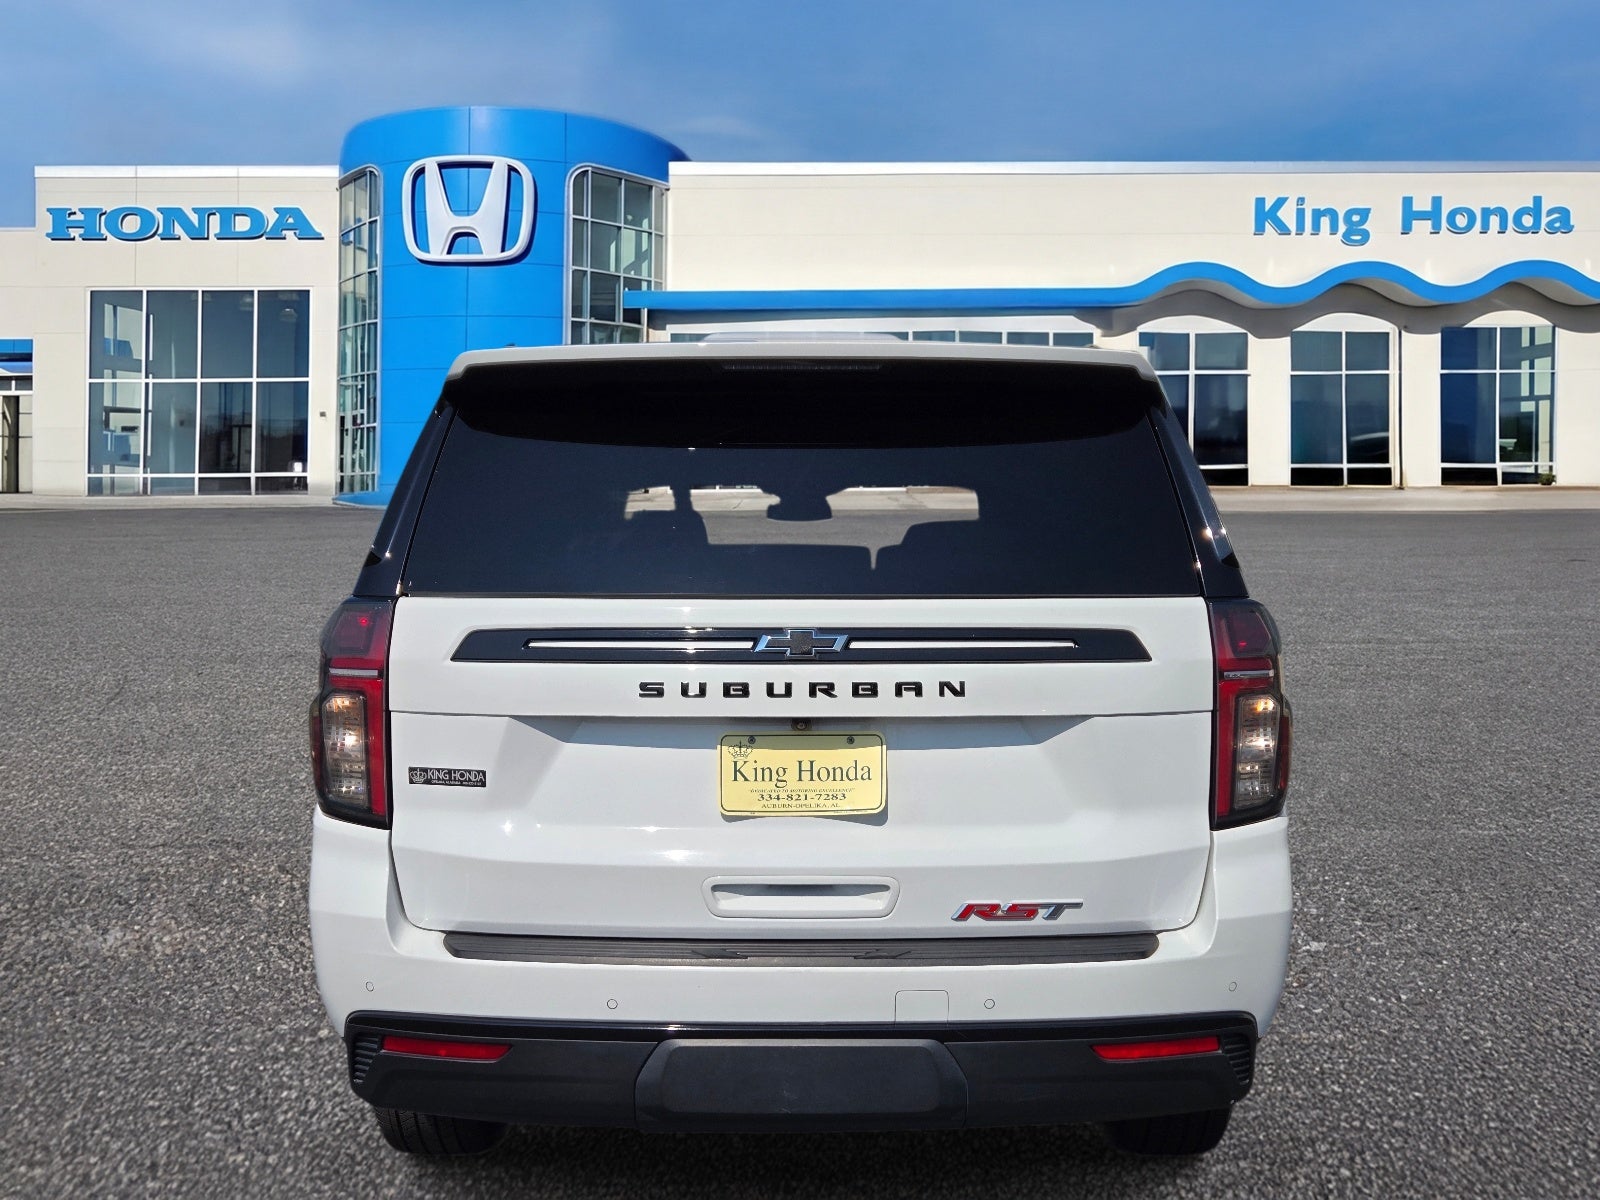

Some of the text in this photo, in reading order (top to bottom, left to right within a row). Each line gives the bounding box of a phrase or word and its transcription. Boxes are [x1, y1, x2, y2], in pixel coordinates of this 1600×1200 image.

[46, 207, 324, 241] HONDA
[1253, 195, 1575, 247] King Honda
[638, 681, 966, 698] SUBURBAN
[428, 769, 485, 782] KING HONDA
[732, 760, 872, 788] King Honda
[757, 793, 847, 802] 334-821-7283
[951, 899, 1084, 922] RST
